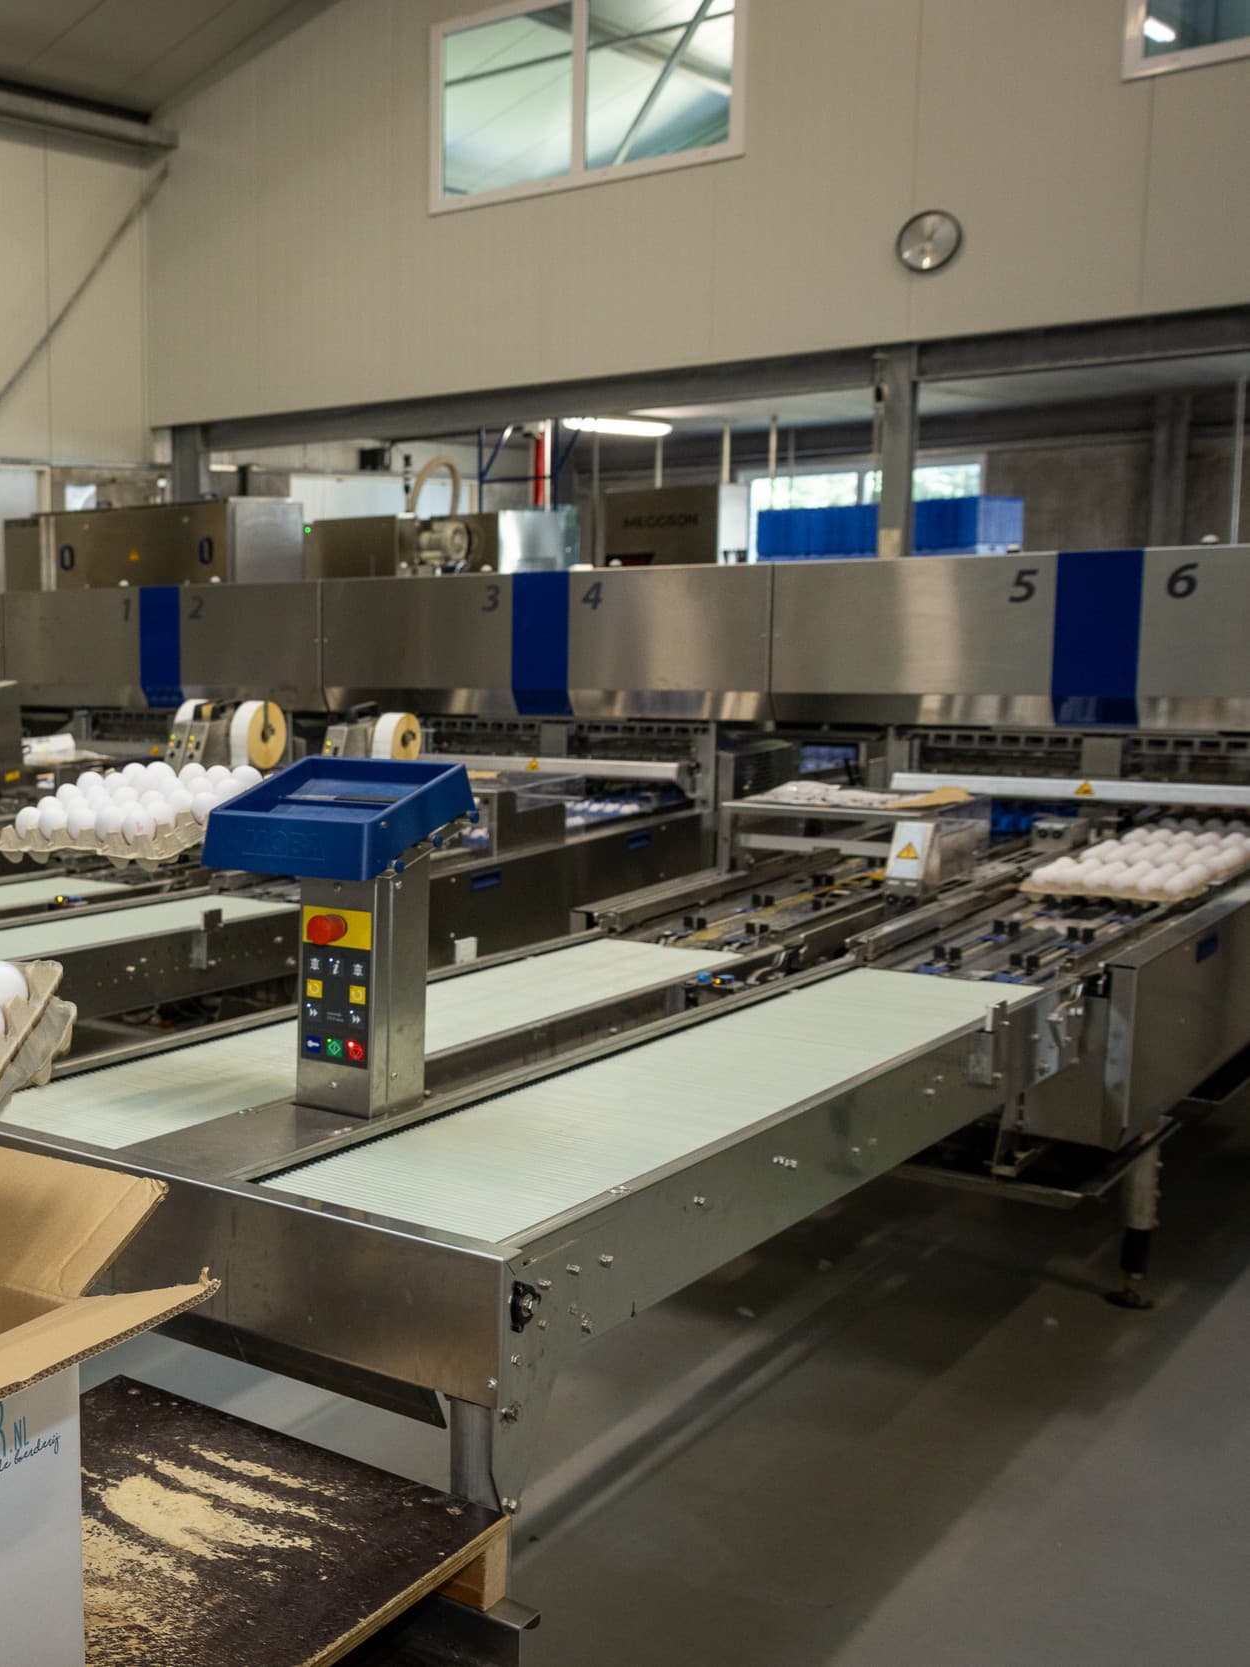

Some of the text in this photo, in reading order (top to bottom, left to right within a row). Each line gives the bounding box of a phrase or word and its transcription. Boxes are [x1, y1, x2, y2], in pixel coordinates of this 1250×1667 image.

[60, 543, 75, 572] 0
[199, 536, 214, 565] 0
[581, 580, 603, 610] 4
[1007, 567, 1040, 603] 5
[1166, 562, 1199, 599] 6
[122, 597, 131, 622] 1
[188, 594, 204, 620] 2
[481, 584, 500, 612] 3
